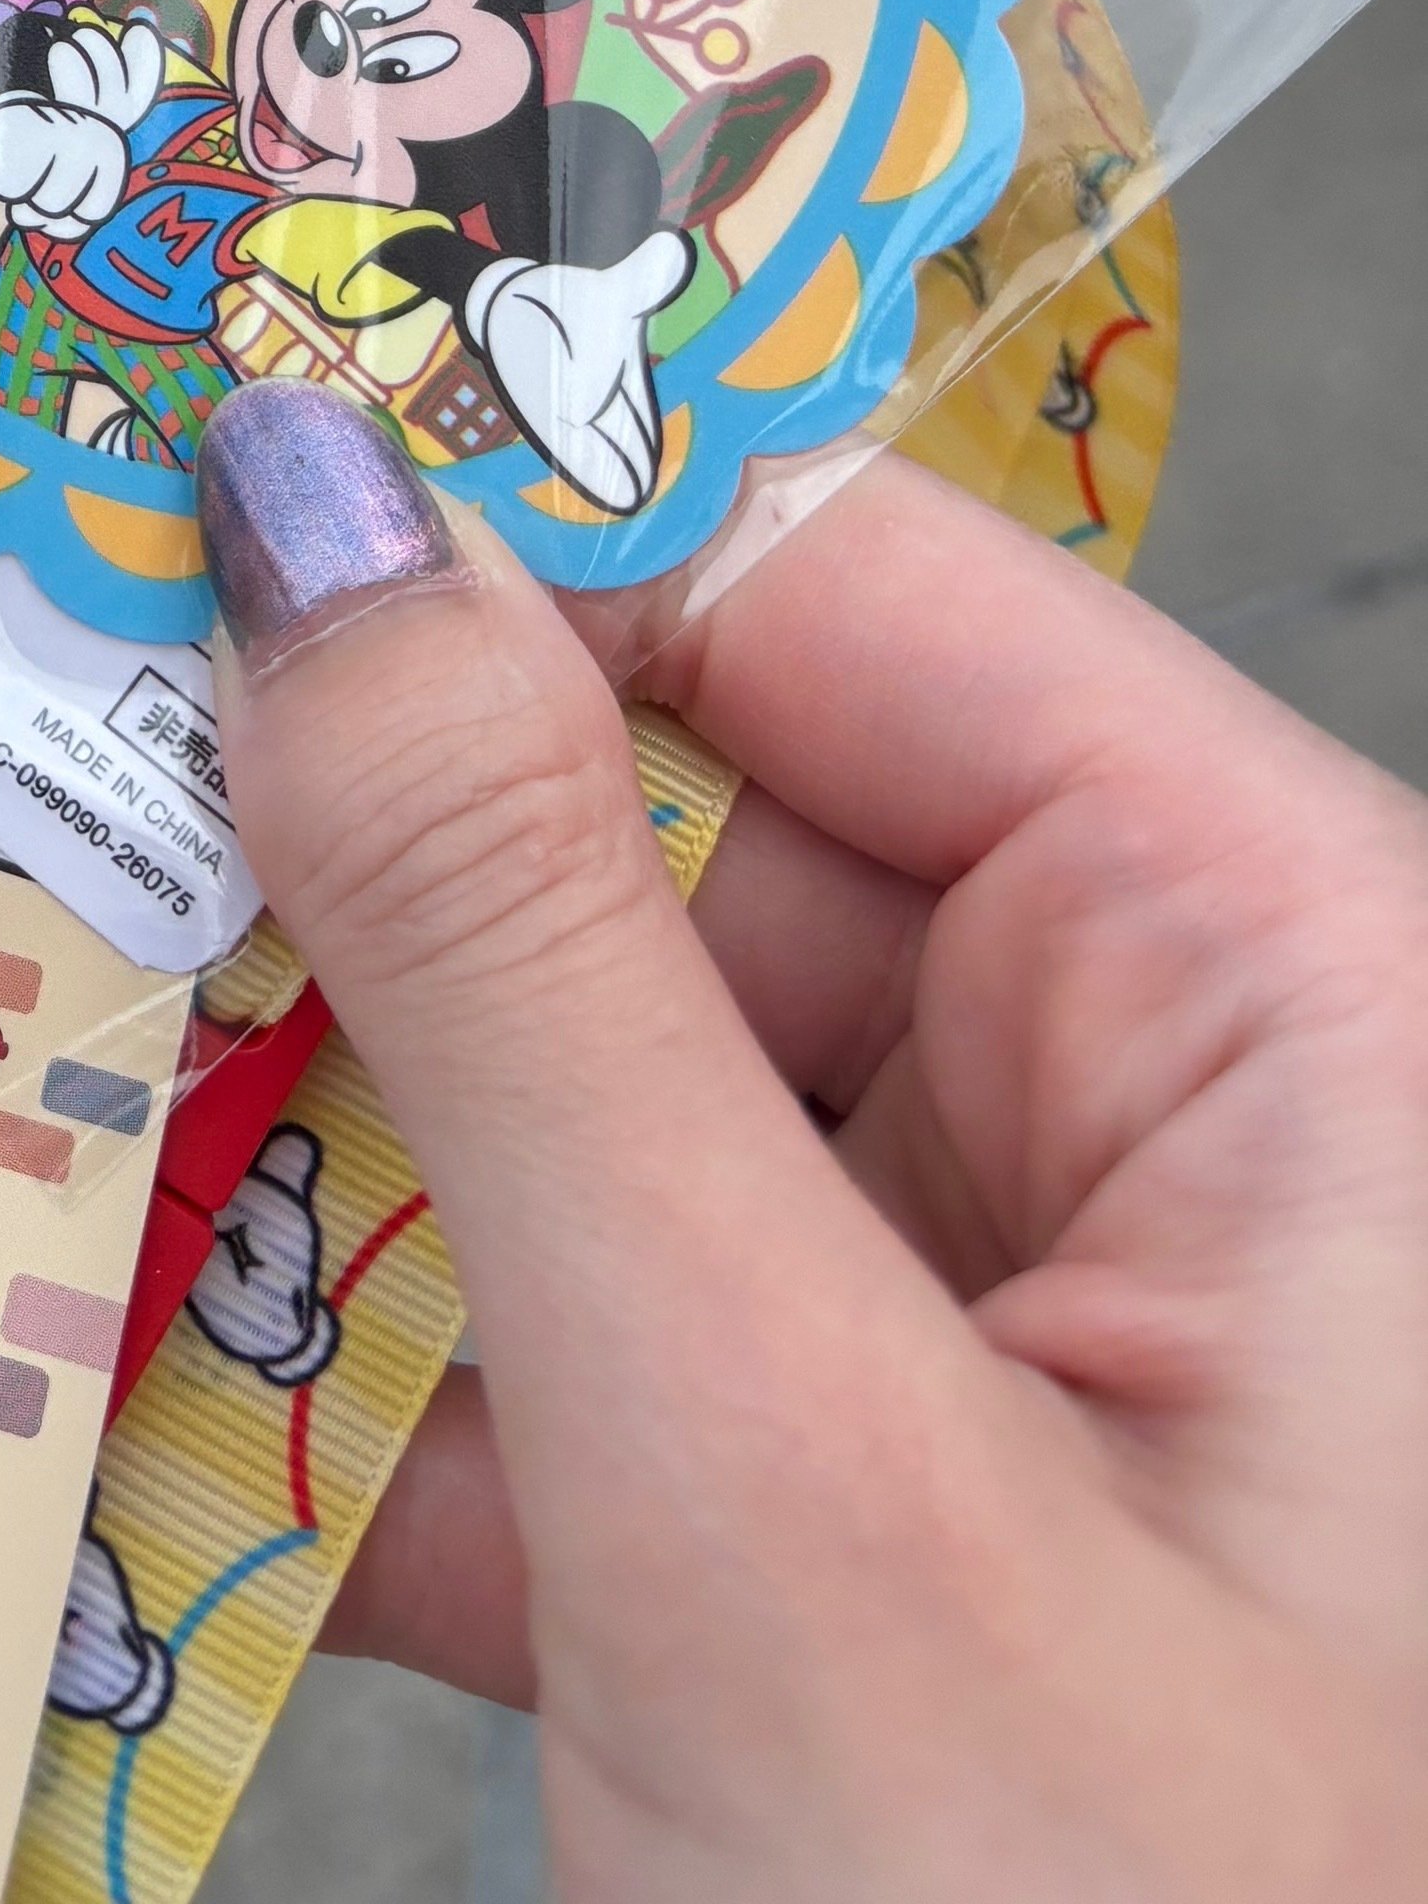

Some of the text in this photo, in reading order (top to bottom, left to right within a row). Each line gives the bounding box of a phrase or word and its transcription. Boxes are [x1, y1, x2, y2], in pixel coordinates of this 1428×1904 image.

[31, 706, 229, 878] MADE IN CHINA
